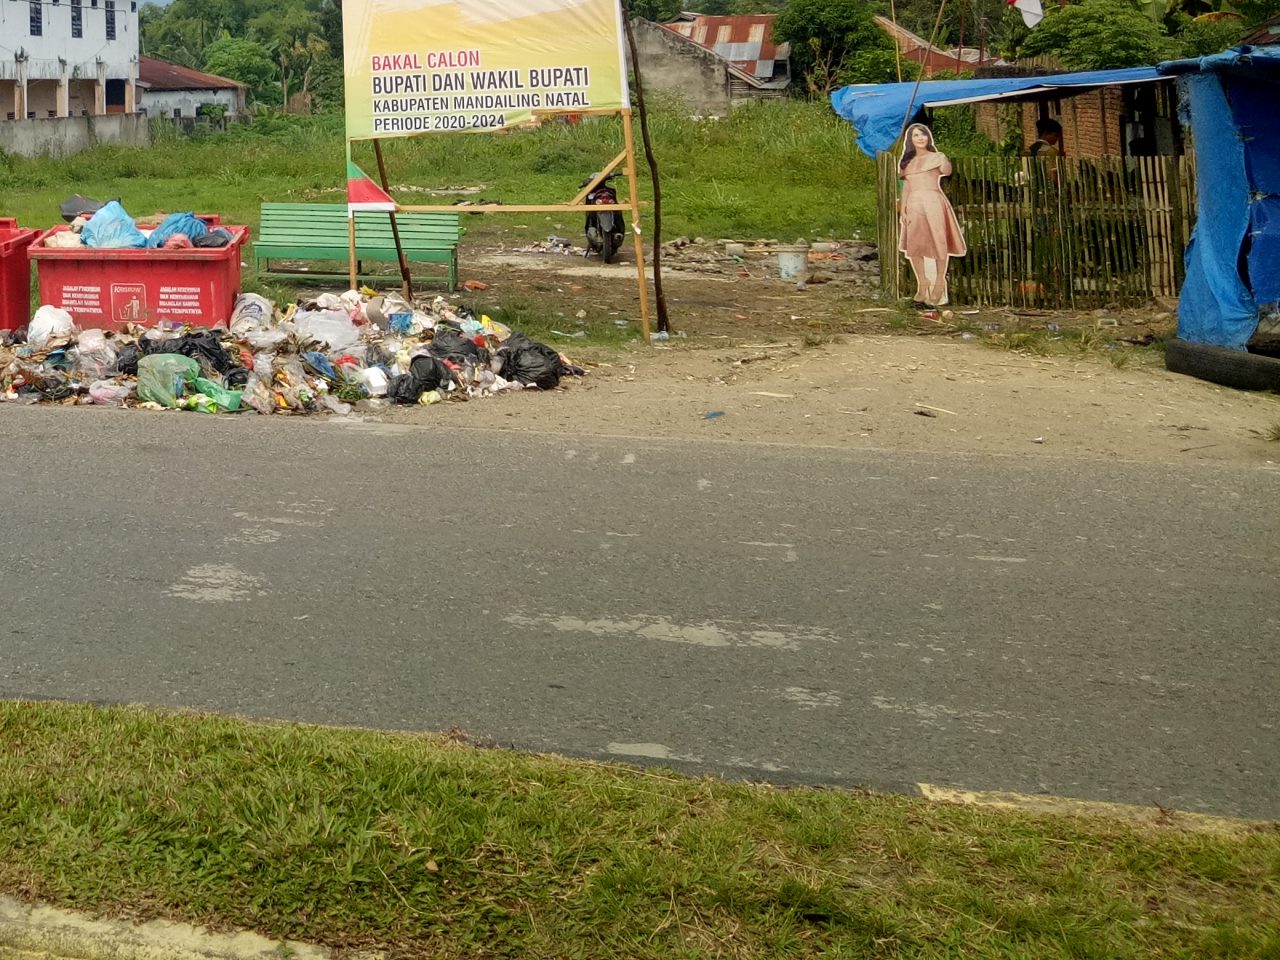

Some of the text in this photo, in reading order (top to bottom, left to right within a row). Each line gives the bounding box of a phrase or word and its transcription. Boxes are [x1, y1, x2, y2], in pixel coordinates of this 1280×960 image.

[372, 50, 480, 71] BAKAL CALON
[373, 67, 589, 94] BUPATI DAN WAKIL BUPATI
[373, 92, 589, 113] KABUPATEN MANDAILING NATAL
[375, 114, 505, 131] PERIODE 2020-2024
